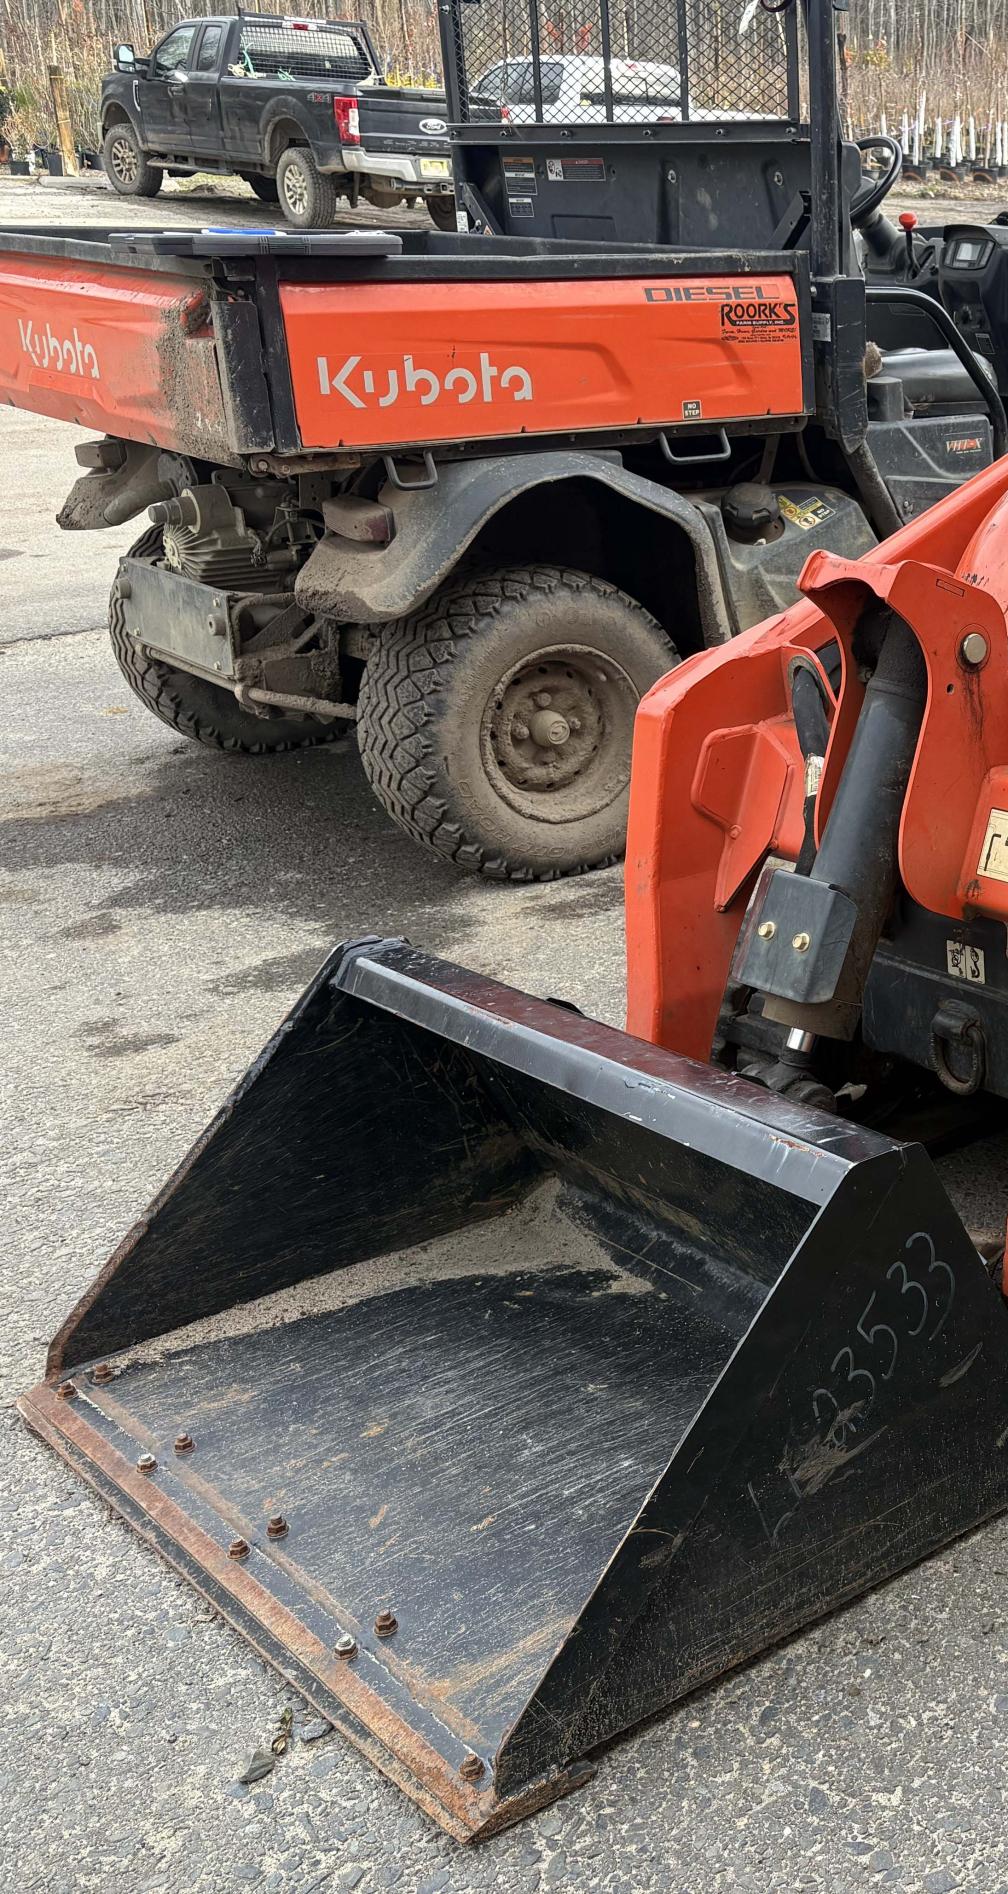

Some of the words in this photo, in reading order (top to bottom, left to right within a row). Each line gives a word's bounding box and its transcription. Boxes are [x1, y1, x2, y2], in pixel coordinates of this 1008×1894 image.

[644, 286, 780, 302] DIESEL
[720, 303, 797, 327] ROORK'S
[17, 318, 100, 379] Kubota
[316, 352, 534, 409] Kubota
[684, 409, 700, 417] STEP
